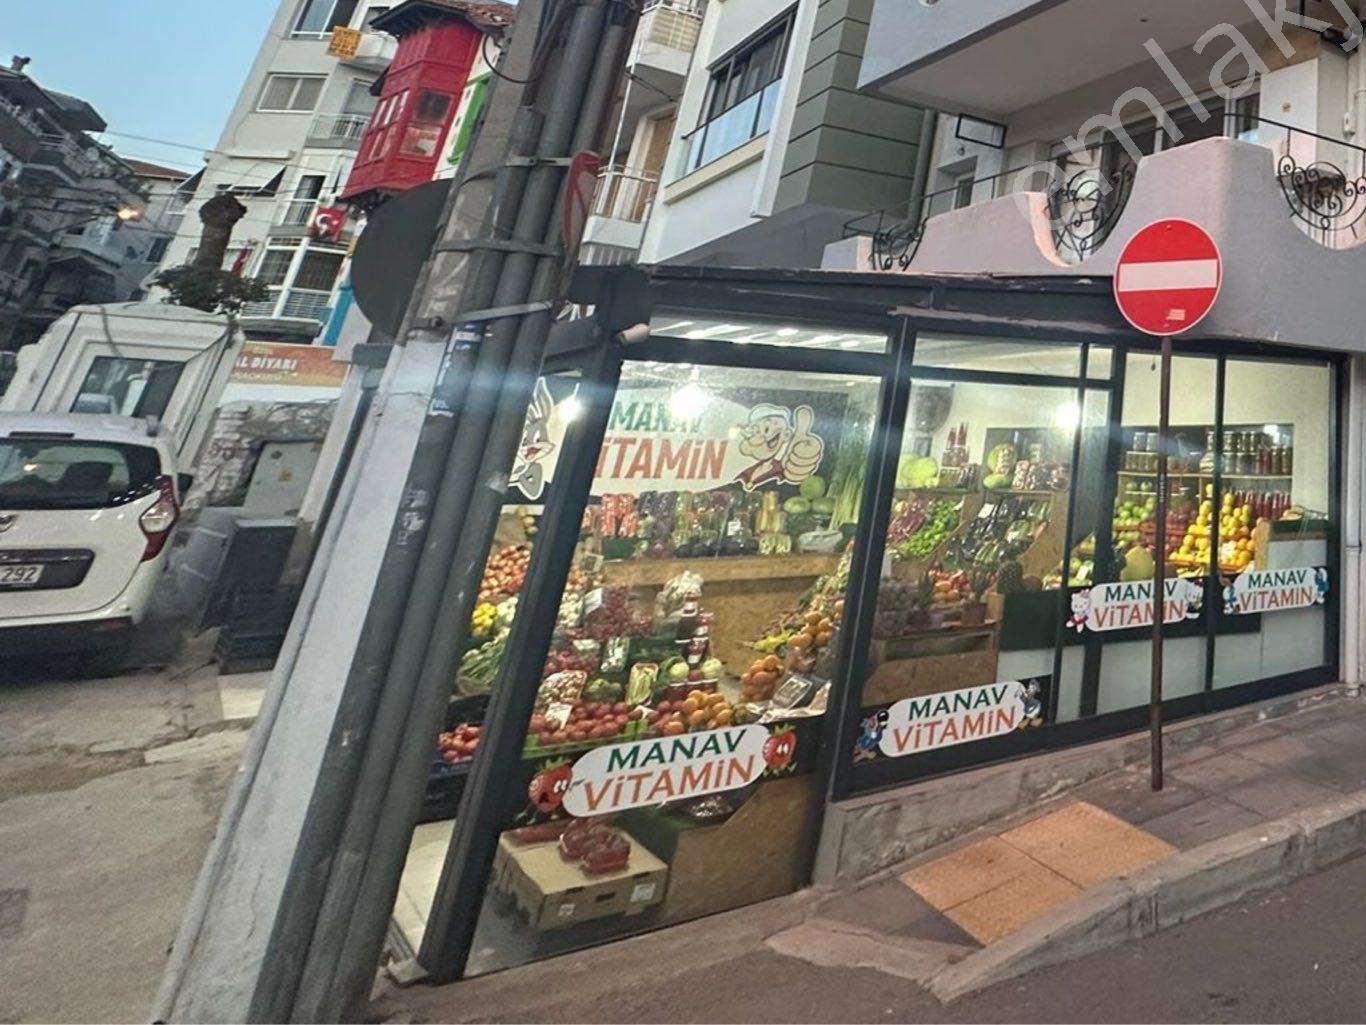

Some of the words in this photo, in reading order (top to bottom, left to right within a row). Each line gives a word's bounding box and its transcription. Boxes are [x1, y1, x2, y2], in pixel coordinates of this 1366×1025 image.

[1105, 581, 1178, 602] MANV
[1248, 570, 1307, 589] MANAV
[909, 685, 1009, 721] MANAV
[606, 728, 747, 773] MANAV
